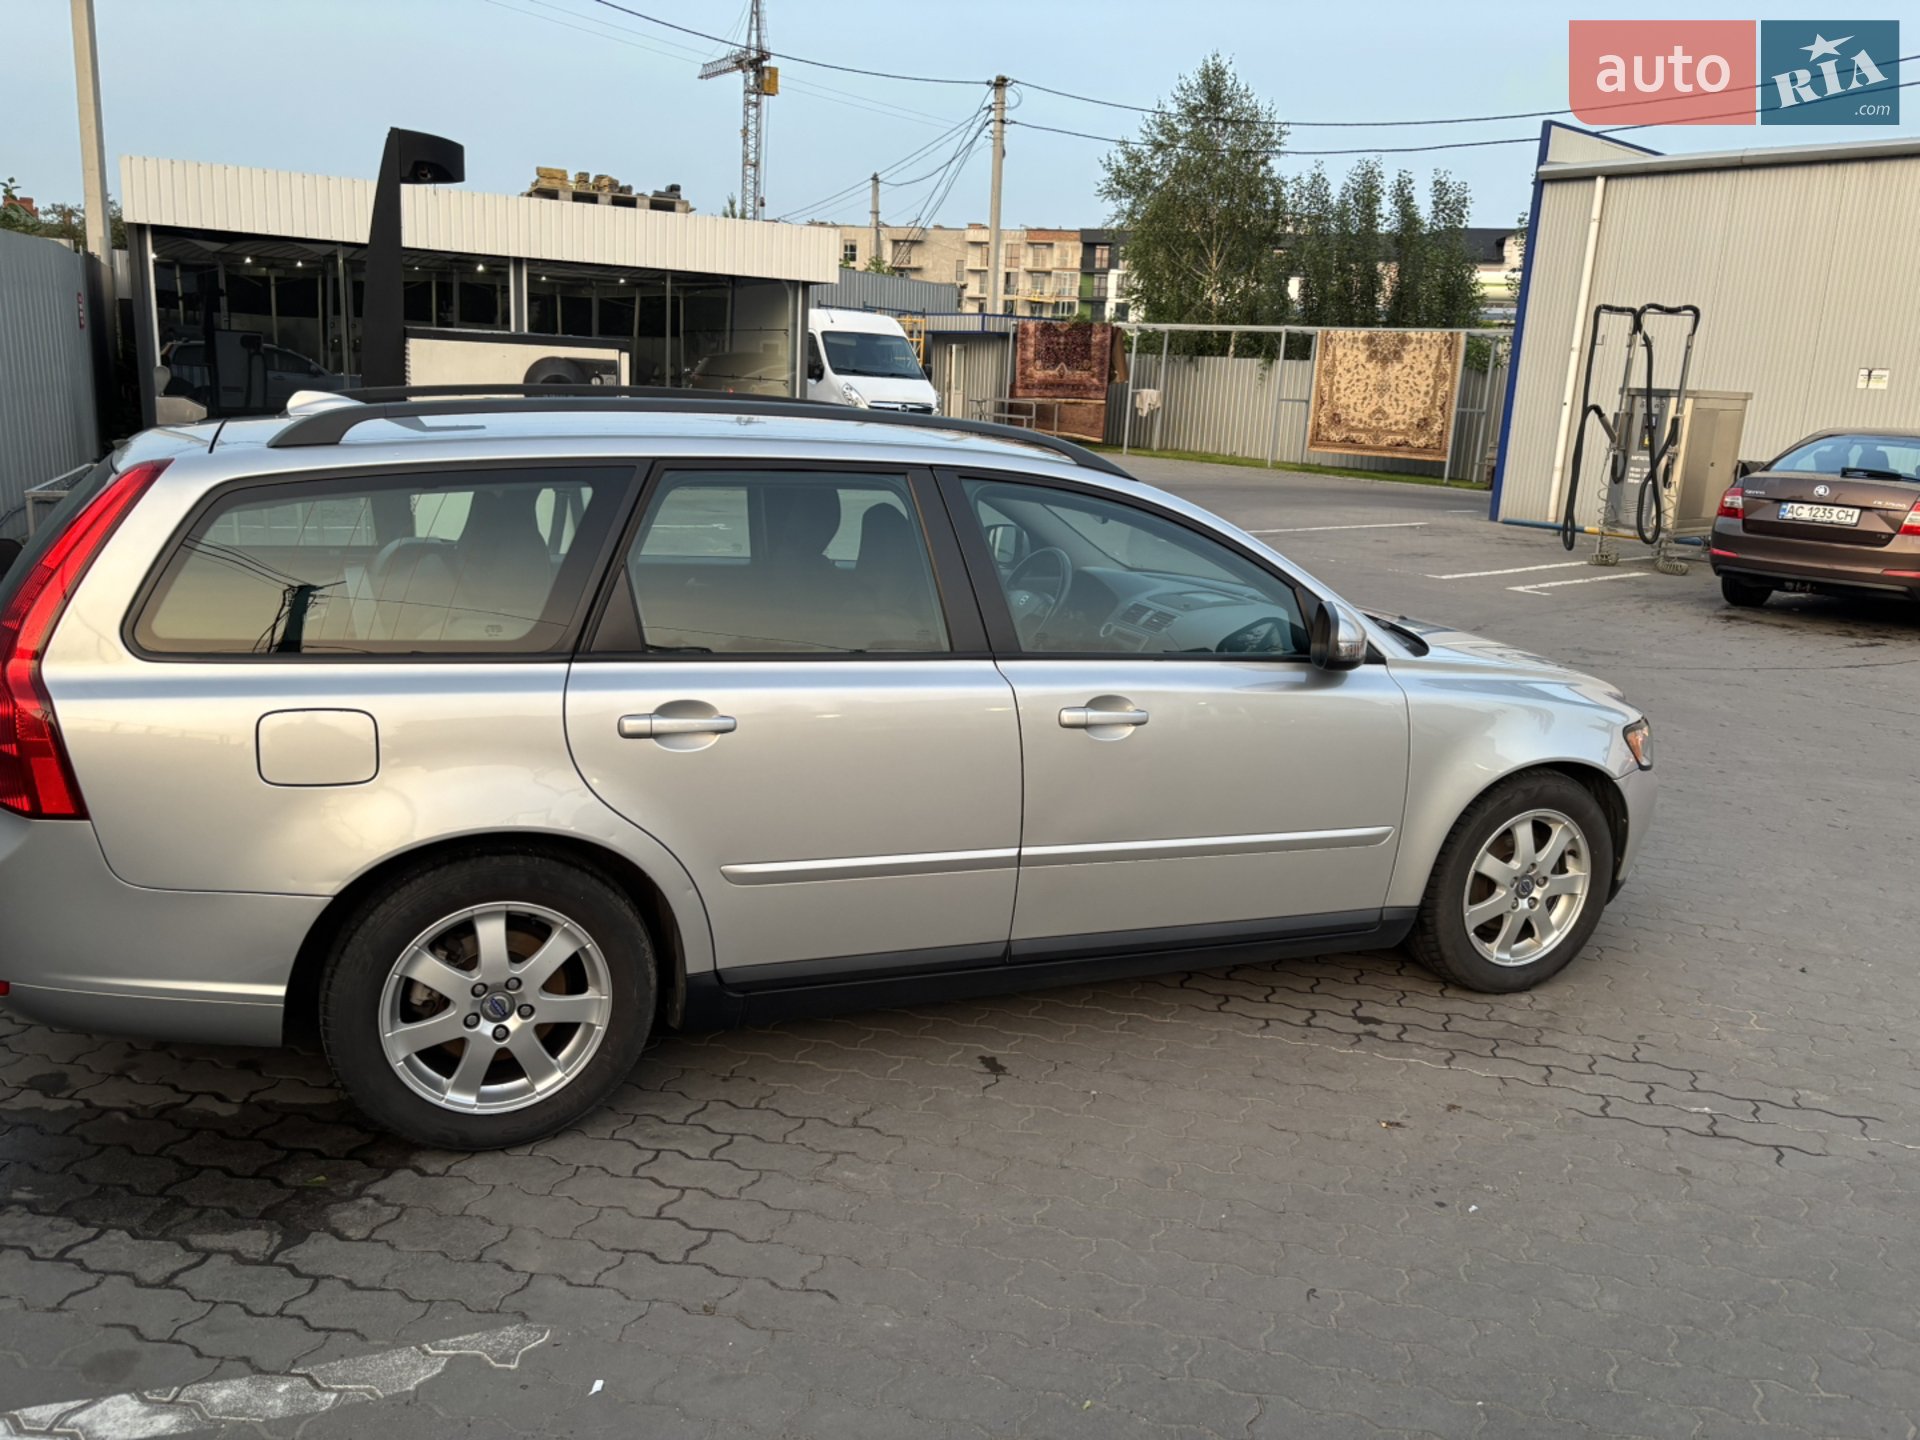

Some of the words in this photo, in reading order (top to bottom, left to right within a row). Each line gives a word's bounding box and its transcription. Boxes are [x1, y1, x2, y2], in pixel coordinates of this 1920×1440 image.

[1786, 505, 1804, 517] AC
[1807, 506, 1834, 519] 1235
[1836, 509, 1855, 521] CH
